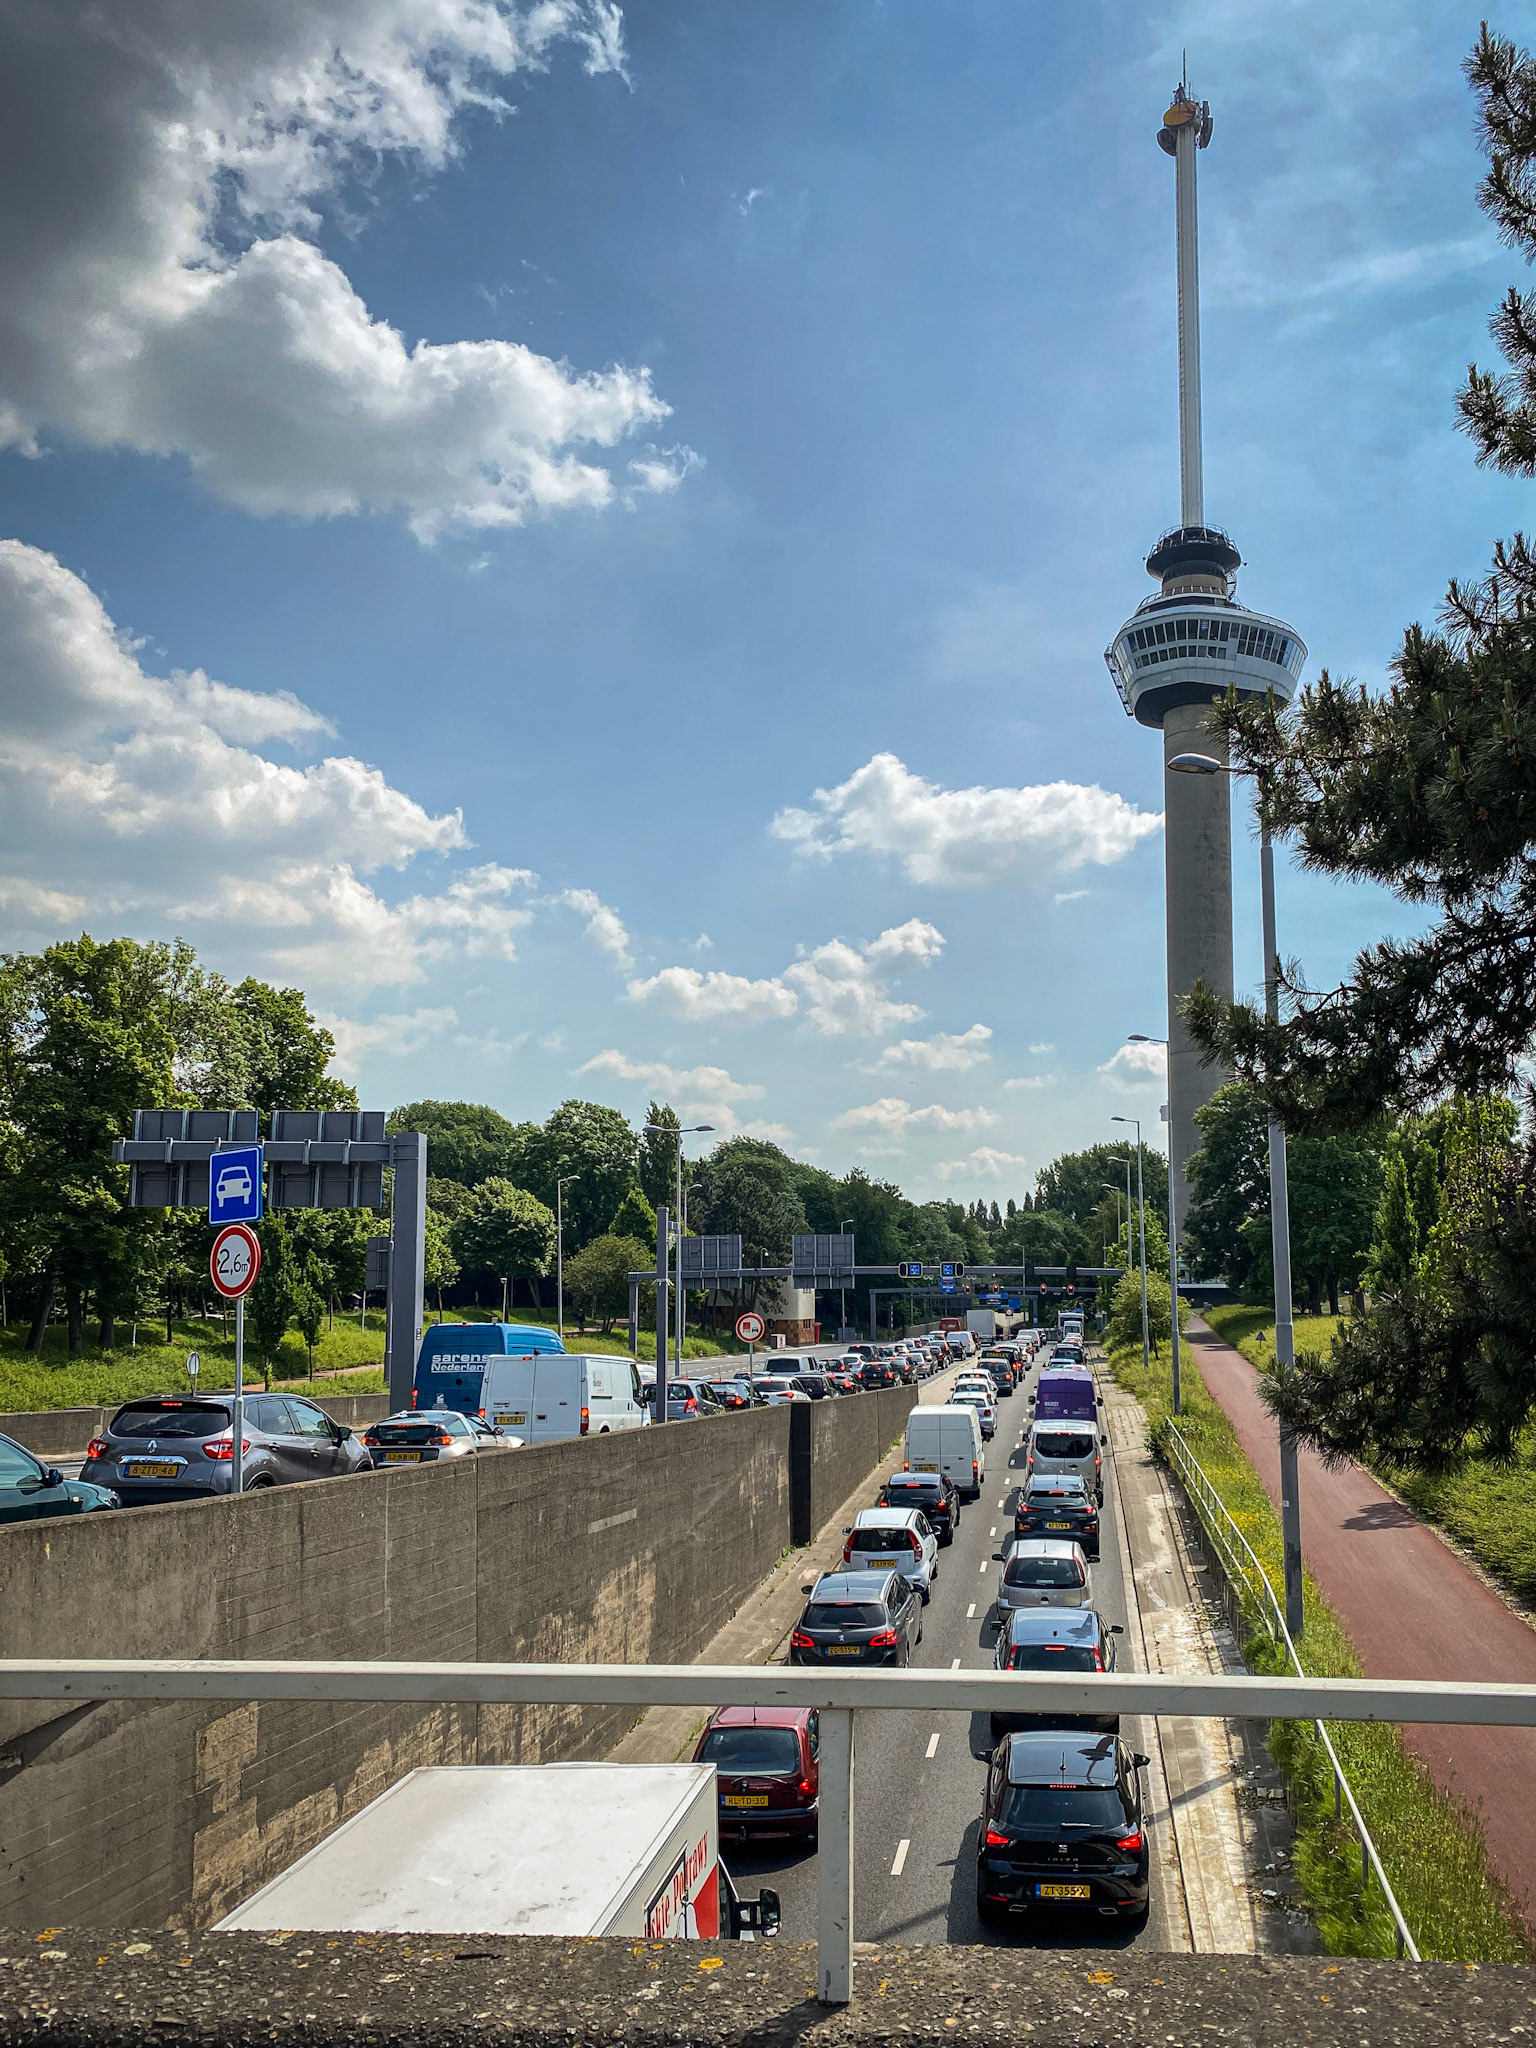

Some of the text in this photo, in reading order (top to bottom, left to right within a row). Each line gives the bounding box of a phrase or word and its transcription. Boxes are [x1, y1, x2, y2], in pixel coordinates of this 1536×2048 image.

[432, 1354, 488, 1362] sarens
[431, 1363, 486, 1371] Nederlan
[132, 1466, 174, 1475] 8-ZTD-46
[728, 1796, 766, 1805] RL-TD-30
[1044, 1885, 1087, 1897] ZT-355-X
